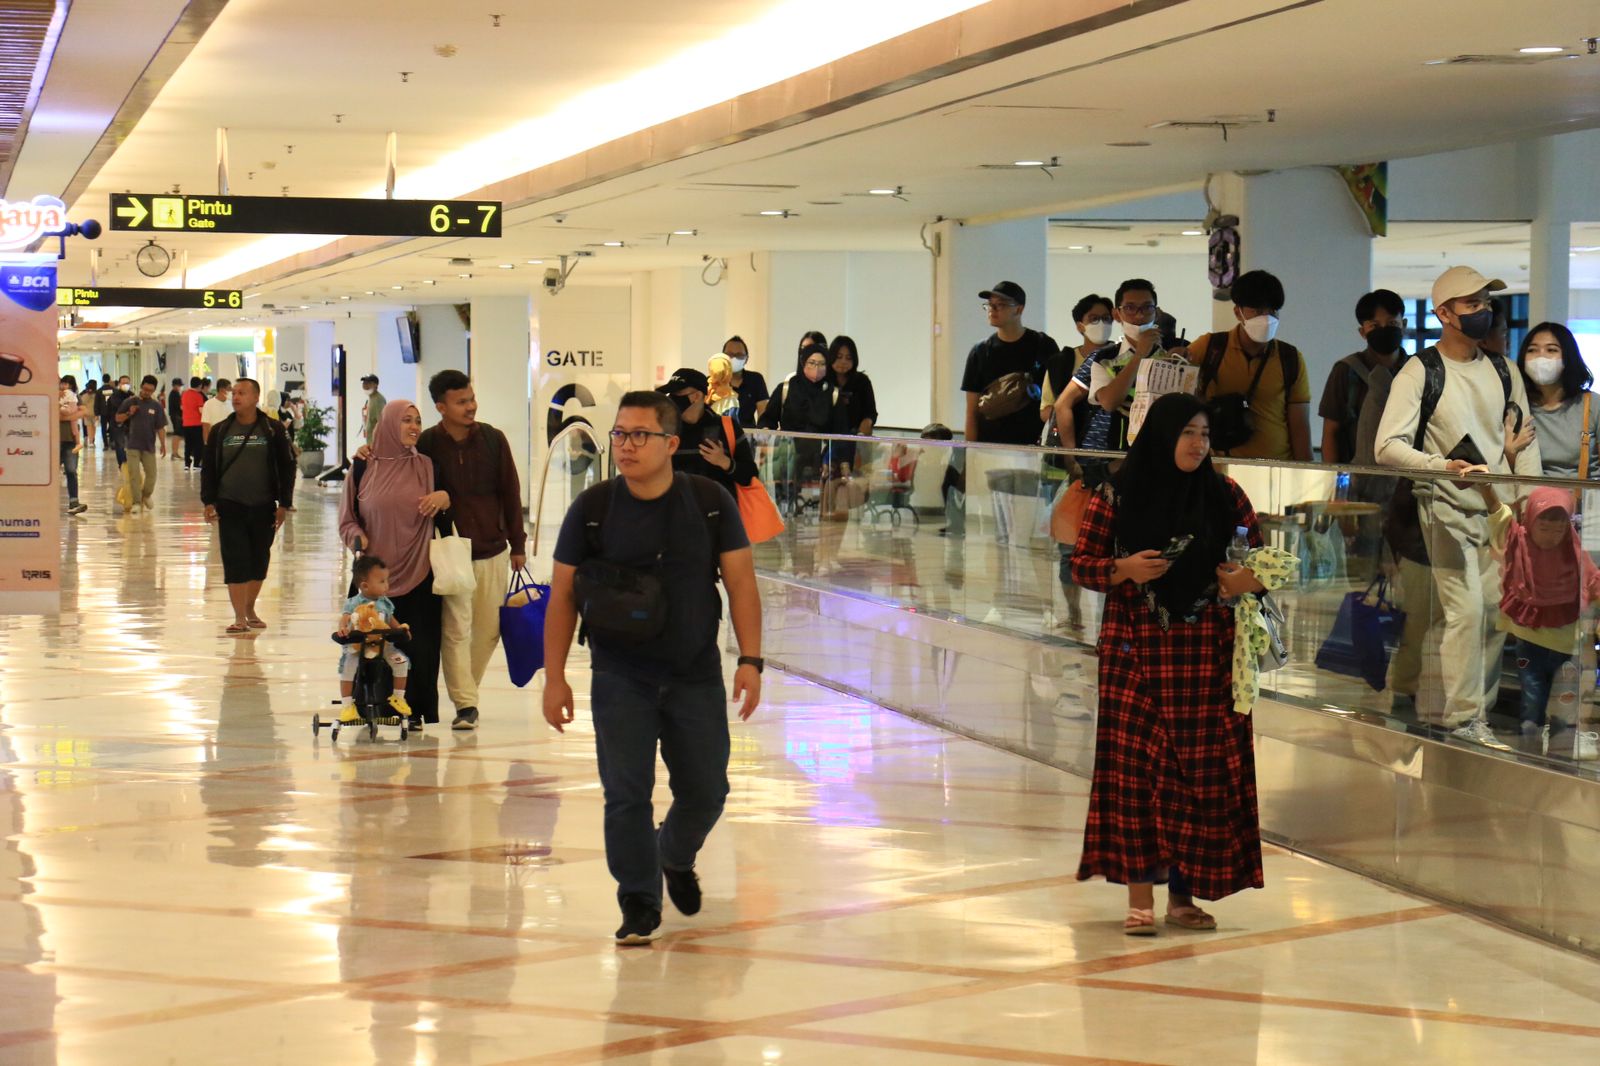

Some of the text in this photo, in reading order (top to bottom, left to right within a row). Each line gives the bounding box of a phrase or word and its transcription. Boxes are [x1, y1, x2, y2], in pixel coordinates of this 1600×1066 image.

[188, 199, 232, 216] Pintu
[188, 218, 216, 228] Gate
[22, 275, 50, 288] BCA
[74, 289, 99, 298] Pintu
[546, 350, 603, 367] GATE
[280, 362, 305, 372] GAT
